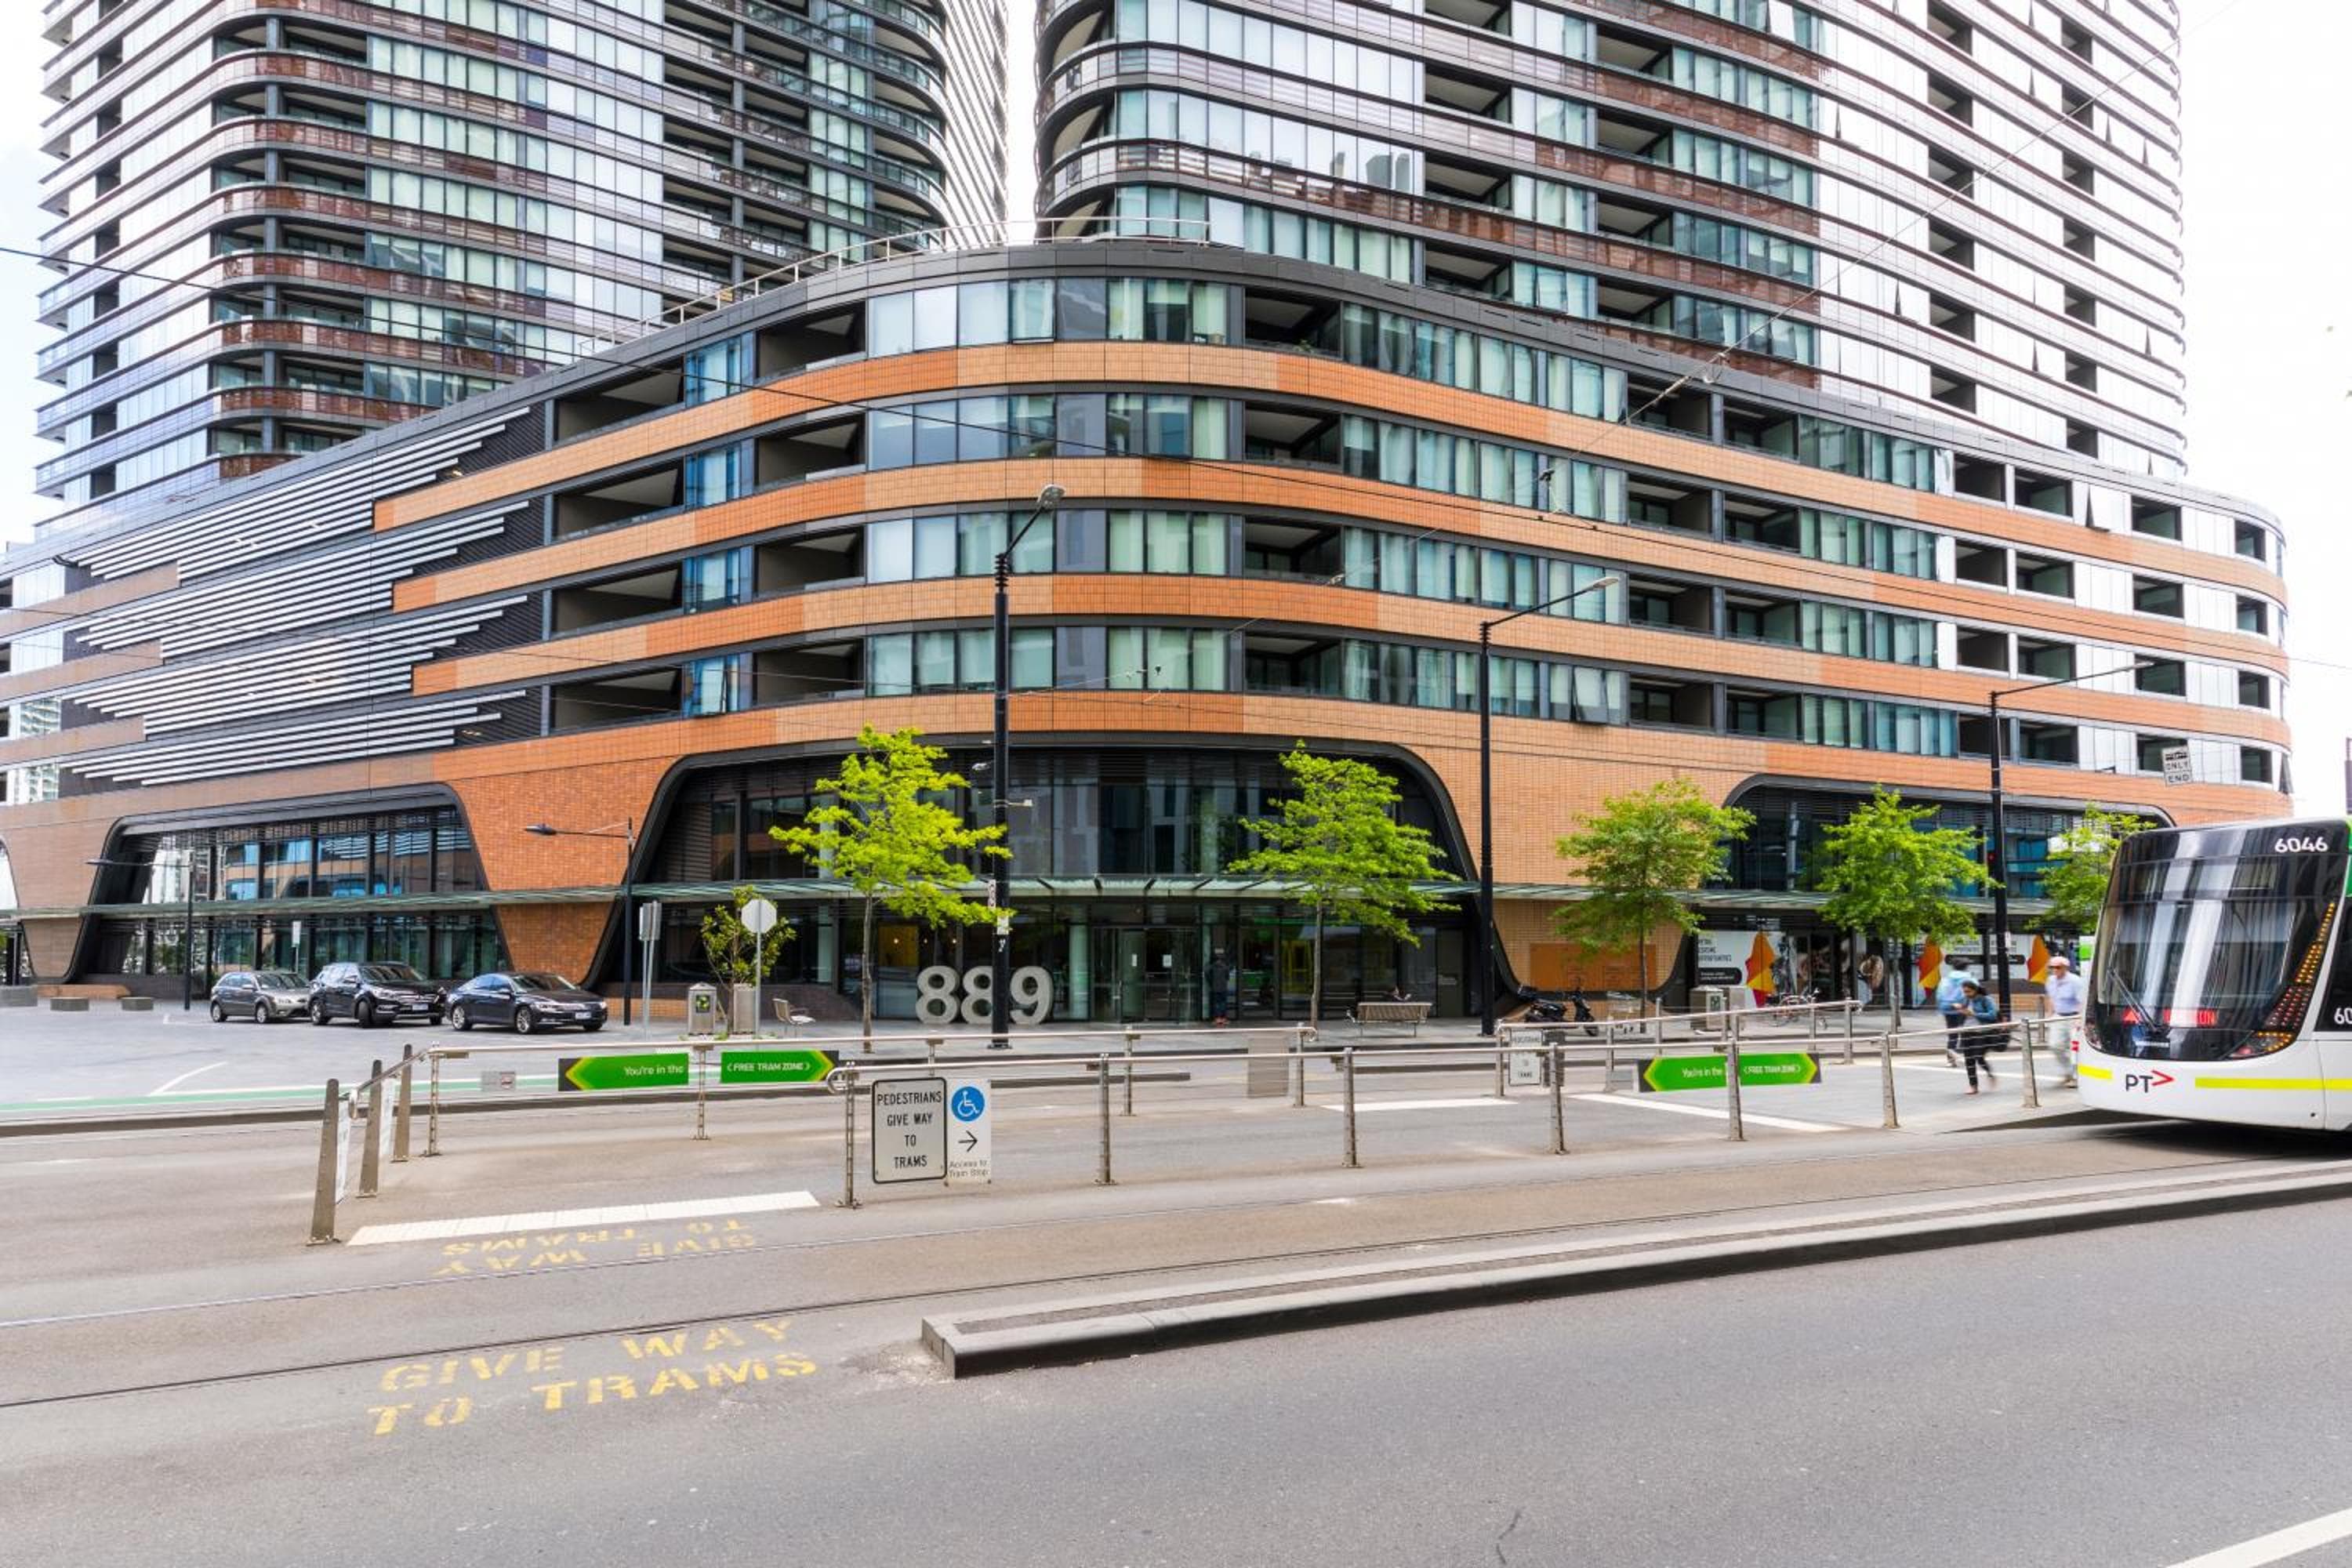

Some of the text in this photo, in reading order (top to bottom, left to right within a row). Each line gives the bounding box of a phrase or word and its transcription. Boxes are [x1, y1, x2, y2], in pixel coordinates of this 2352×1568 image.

[2274, 836, 2328, 853] 6046
[915, 965, 1054, 1024] 889
[623, 1065, 684, 1076] You're in the
[782, 1062, 804, 1071] ZONE
[877, 1091, 942, 1105] PEDESTRIANS
[887, 1112, 933, 1127] GIVE WAY
[904, 1134, 916, 1147] TO
[894, 1155, 927, 1169] TRAMS
[949, 1169, 969, 1178] Tram
[382, 1321, 790, 1392] GIVE WAY
[368, 1352, 816, 1435] TO TRAMS
